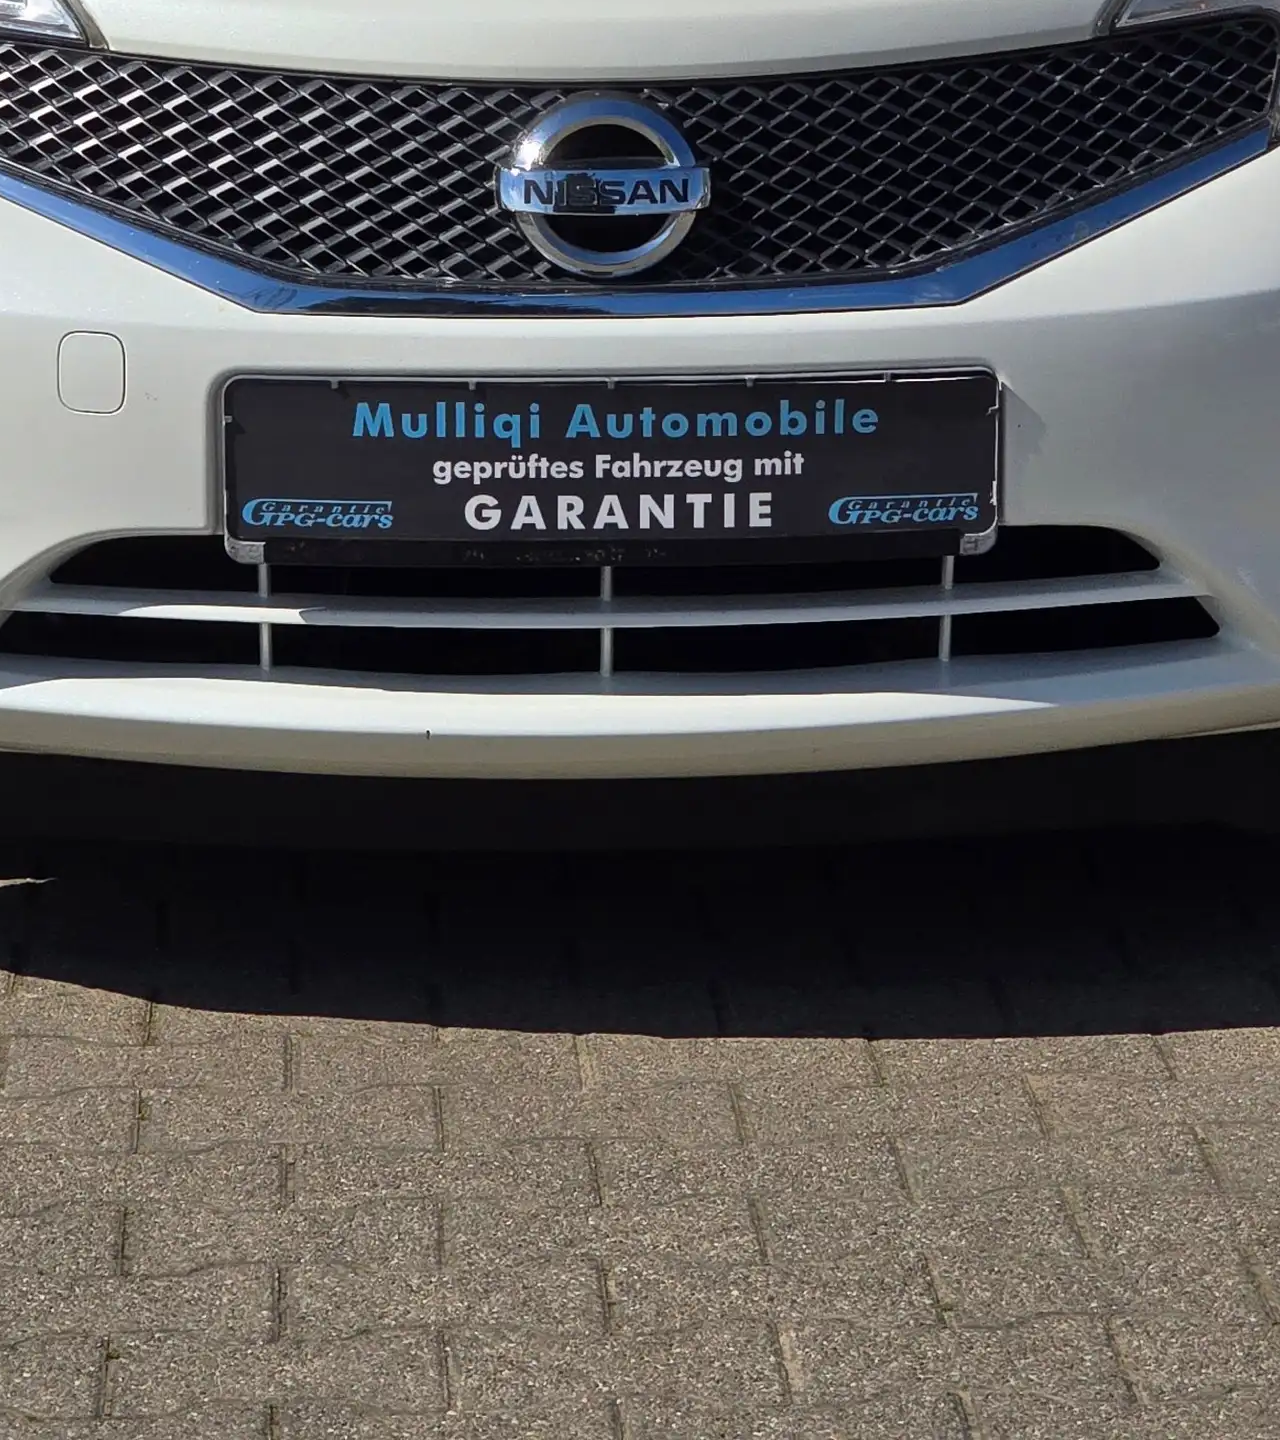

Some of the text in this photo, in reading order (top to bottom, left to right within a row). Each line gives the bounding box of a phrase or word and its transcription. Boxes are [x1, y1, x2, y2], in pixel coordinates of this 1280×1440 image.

[523, 178, 689, 206] NISSAN
[352, 399, 879, 449] Mulliqi Automobile
[433, 450, 805, 485] geprüftes Fahrzeug mit
[261, 501, 385, 515] Garantie
[464, 492, 773, 531] GARANTIE
[847, 496, 972, 510] Garantie
